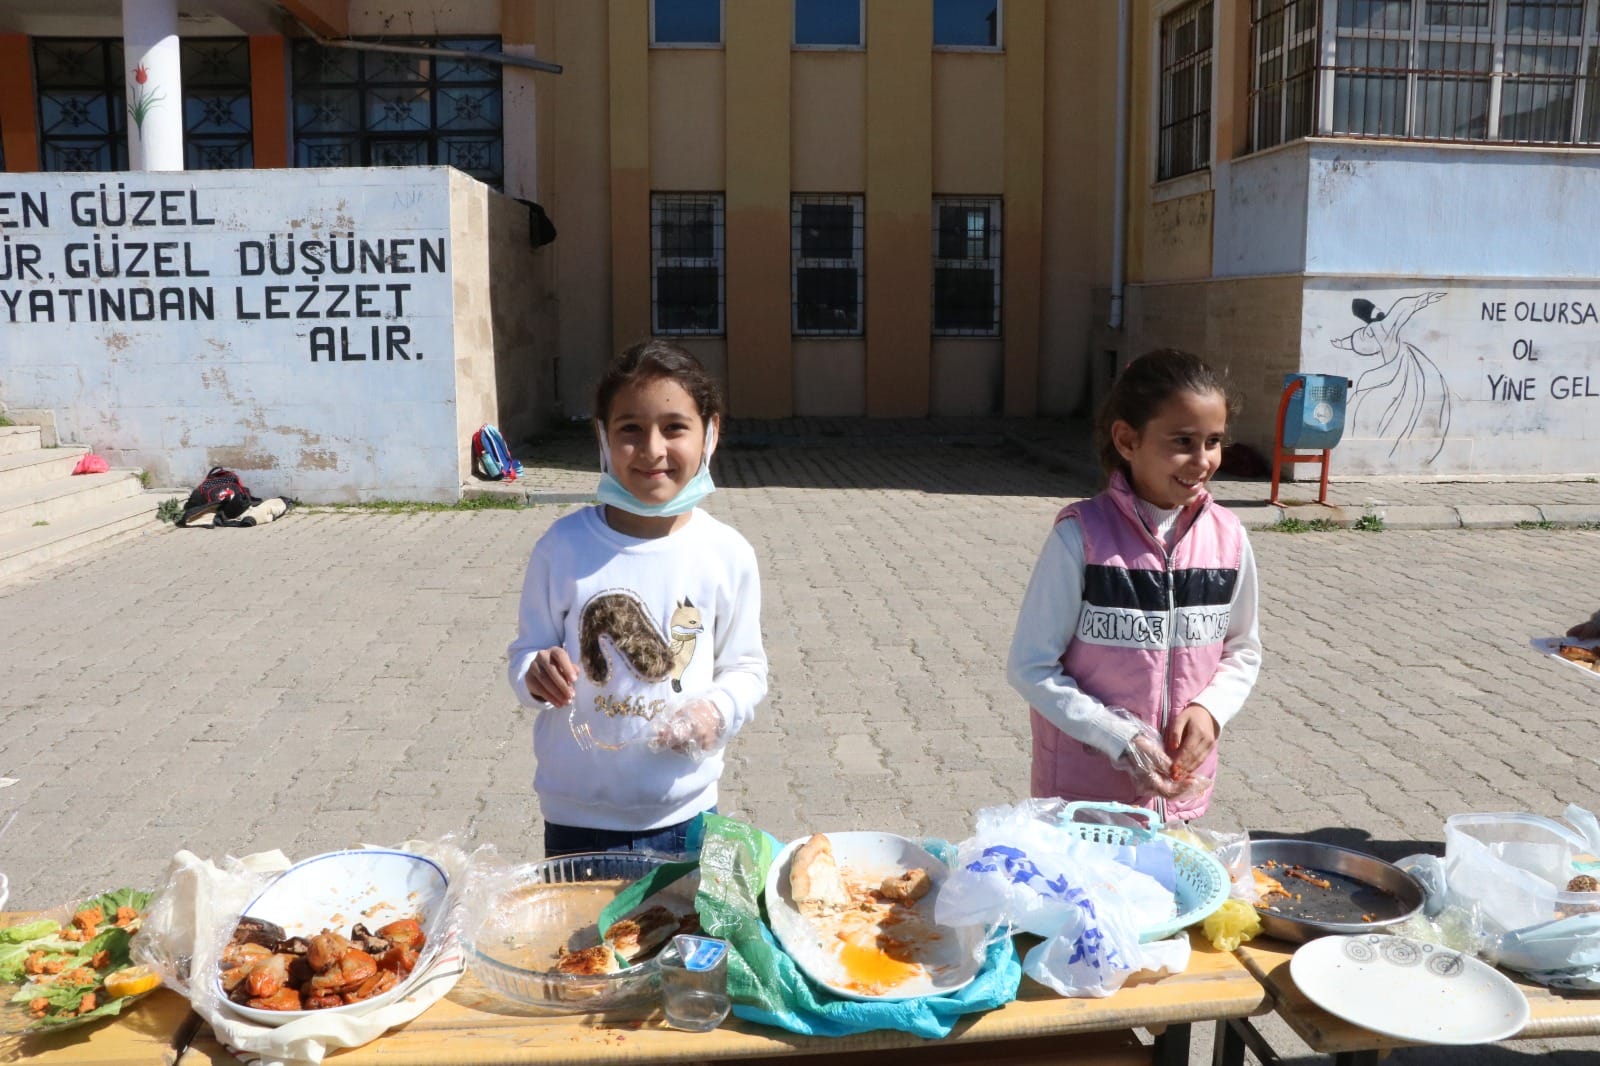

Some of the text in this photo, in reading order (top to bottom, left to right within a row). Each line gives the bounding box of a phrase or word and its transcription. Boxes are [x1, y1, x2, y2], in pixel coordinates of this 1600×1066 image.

[71, 182, 215, 227] GÜZEL
[64, 233, 210, 279] GÜZEL
[239, 231, 446, 282] DÜŞÜNEN
[0, 283, 411, 322] YATINDAN LEZZET
[1481, 301, 1599, 324] NE OLURSA
[309, 325, 423, 362] ALIR.
[1512, 339, 1539, 361] OL
[1550, 375, 1600, 400] GEL
